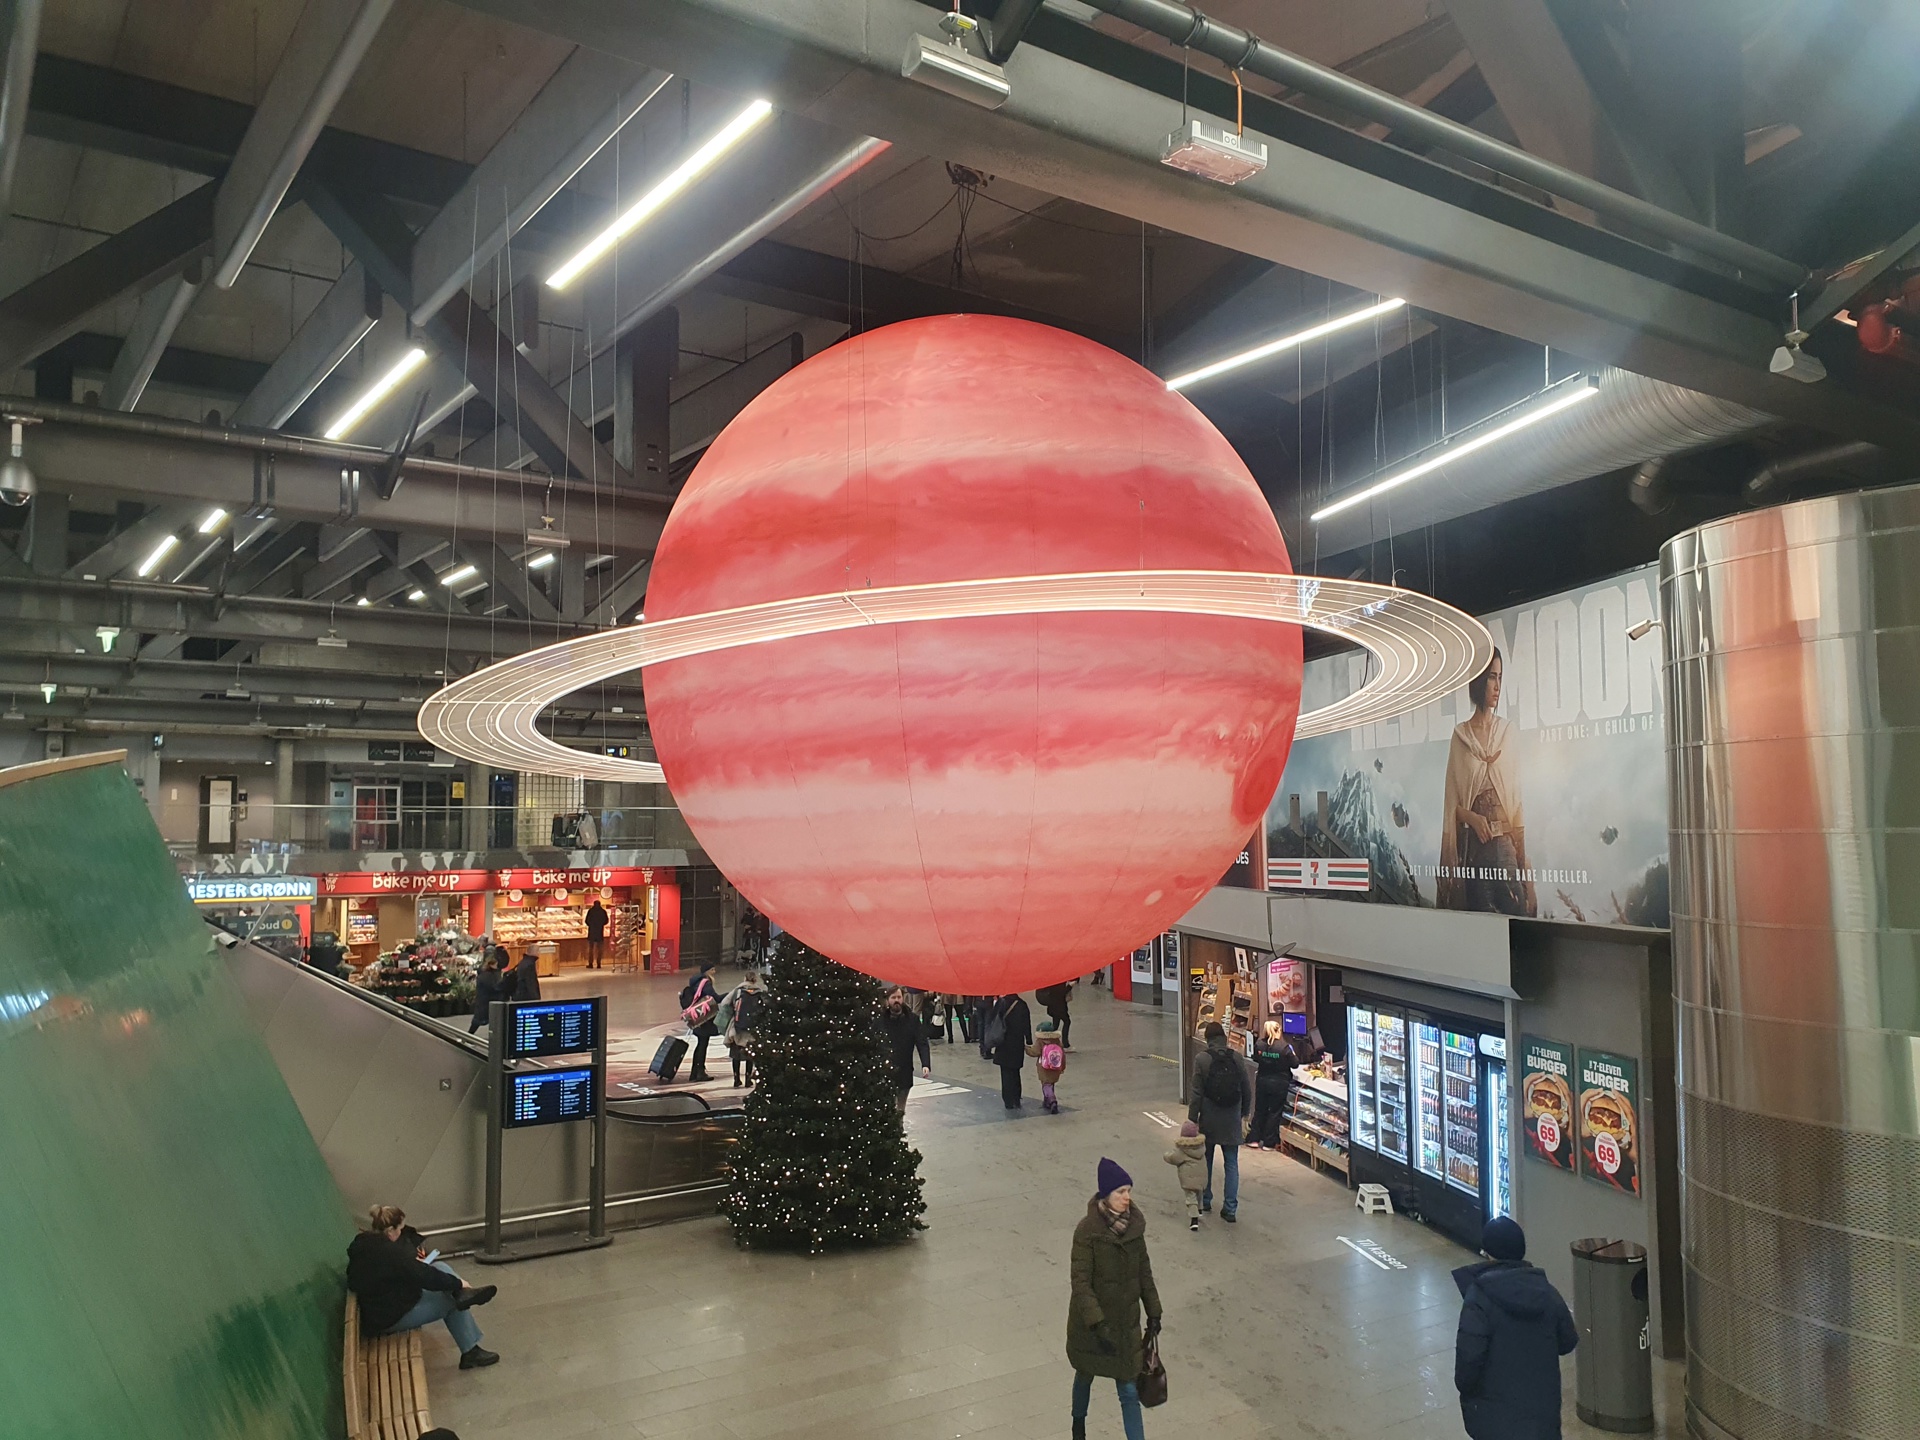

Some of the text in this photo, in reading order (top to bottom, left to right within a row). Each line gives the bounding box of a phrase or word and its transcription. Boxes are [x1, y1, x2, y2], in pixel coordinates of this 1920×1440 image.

[1488, 573, 1665, 730] MOON
[1540, 727, 1562, 743] PART
[1567, 724, 1589, 740] ONE:
[1594, 721, 1600, 737] A
[1605, 717, 1636, 735] CHILD
[1641, 714, 1654, 731] OF
[413, 875, 436, 889] me
[568, 872, 591, 885] me
[1425, 865, 1449, 878] FINNES
[1453, 866, 1475, 879] INGEN
[1479, 867, 1511, 881] HELTER.
[1516, 868, 1537, 882] BARE
[1541, 869, 1592, 884] REBELLER.
[249, 882, 312, 897] GRØNN
[1527, 1055, 1567, 1077] BURGER
[1583, 1069, 1629, 1093] BURGER
[1356, 1238, 1408, 1270] Til kassen
